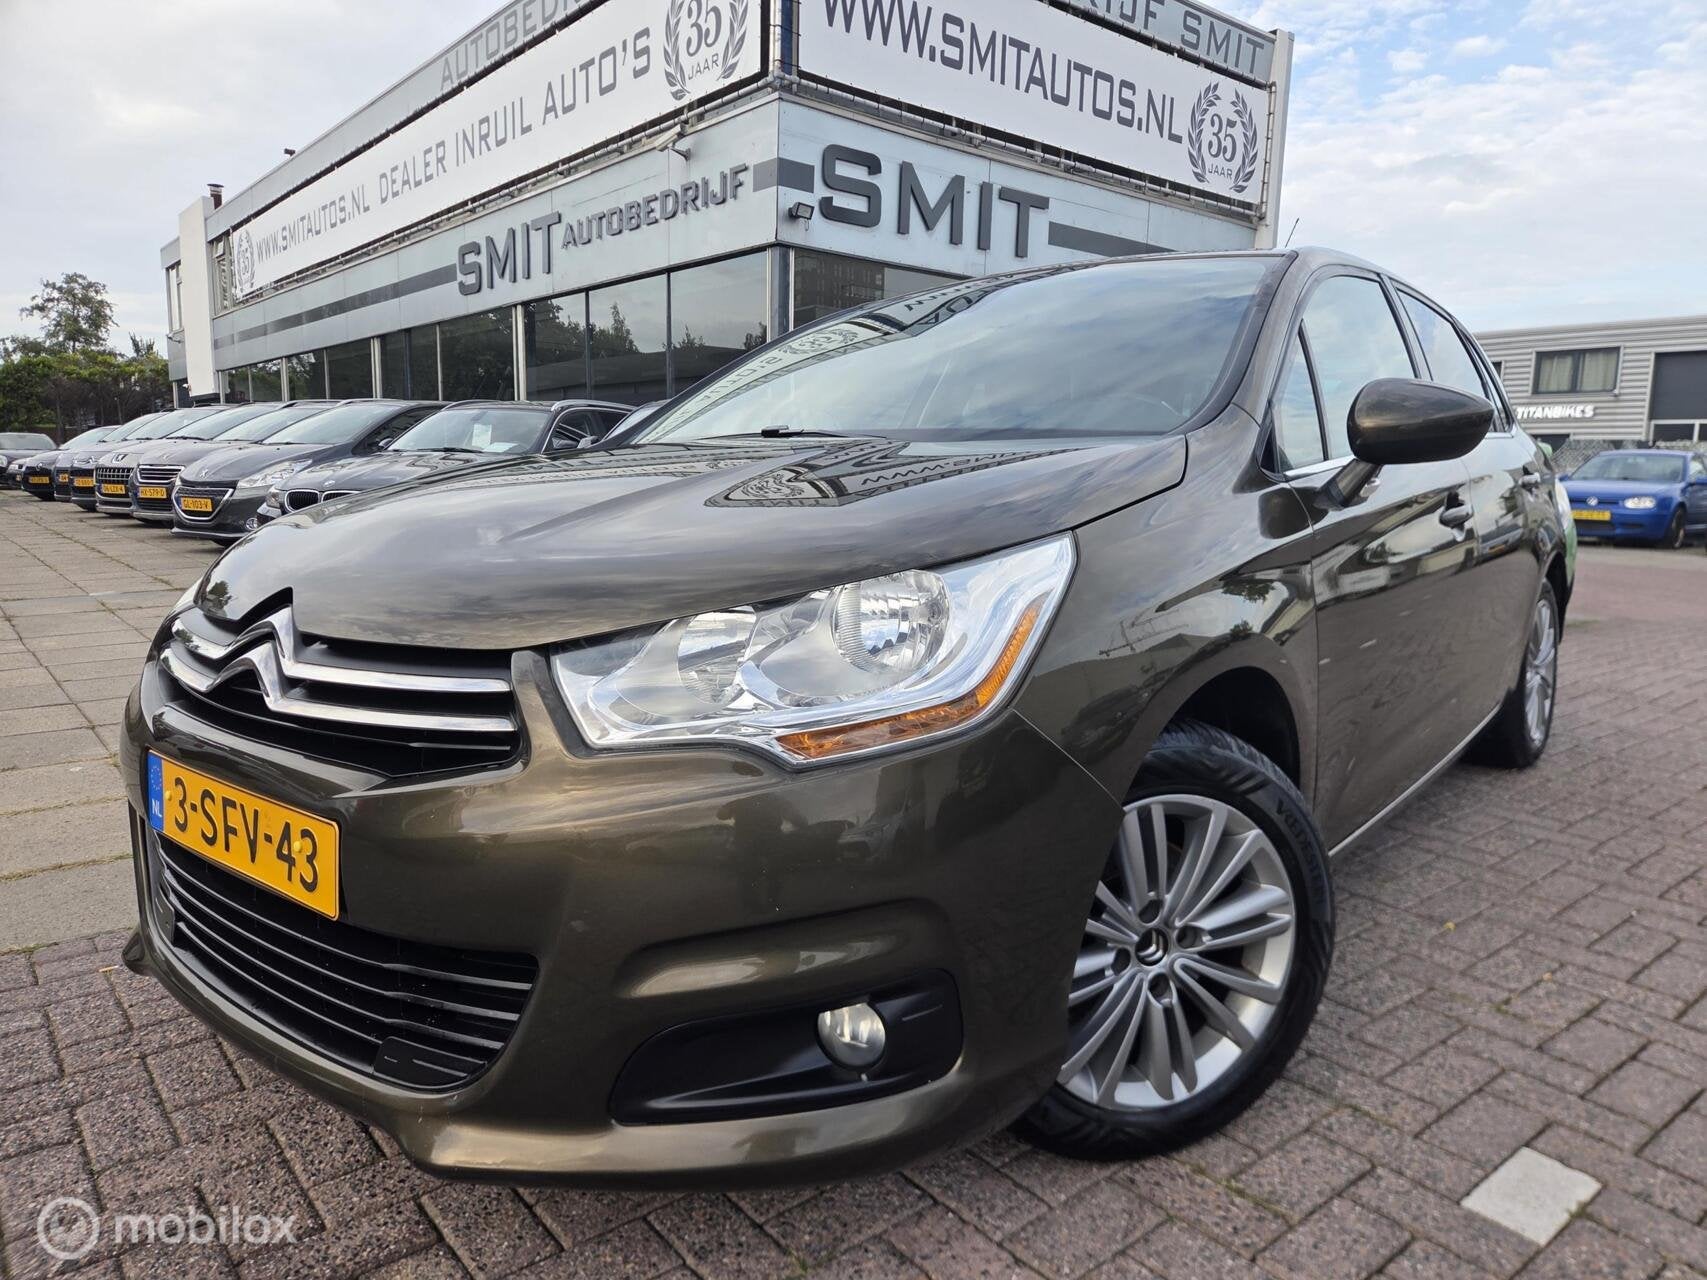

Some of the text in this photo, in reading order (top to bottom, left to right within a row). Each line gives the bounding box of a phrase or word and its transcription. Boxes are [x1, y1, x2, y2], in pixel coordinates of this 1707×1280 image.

[686, 0, 721, 57] 35
[1181, 10, 1264, 74] SMIT
[688, 53, 719, 80] JAAR
[256, 27, 651, 264] WWW.SMITAUTOS.NL DEALER INRUIL AUTO'S
[1208, 113, 1237, 163] 35
[1208, 163, 1233, 180] JAAR
[457, 163, 748, 296] SMIT AUTOBEDRIJF
[819, 144, 1050, 258] SMIT
[1516, 405, 1595, 419] TITANBIKES
[152, 798, 163, 818] NL
[174, 776, 319, 893] 3-SFV-43
